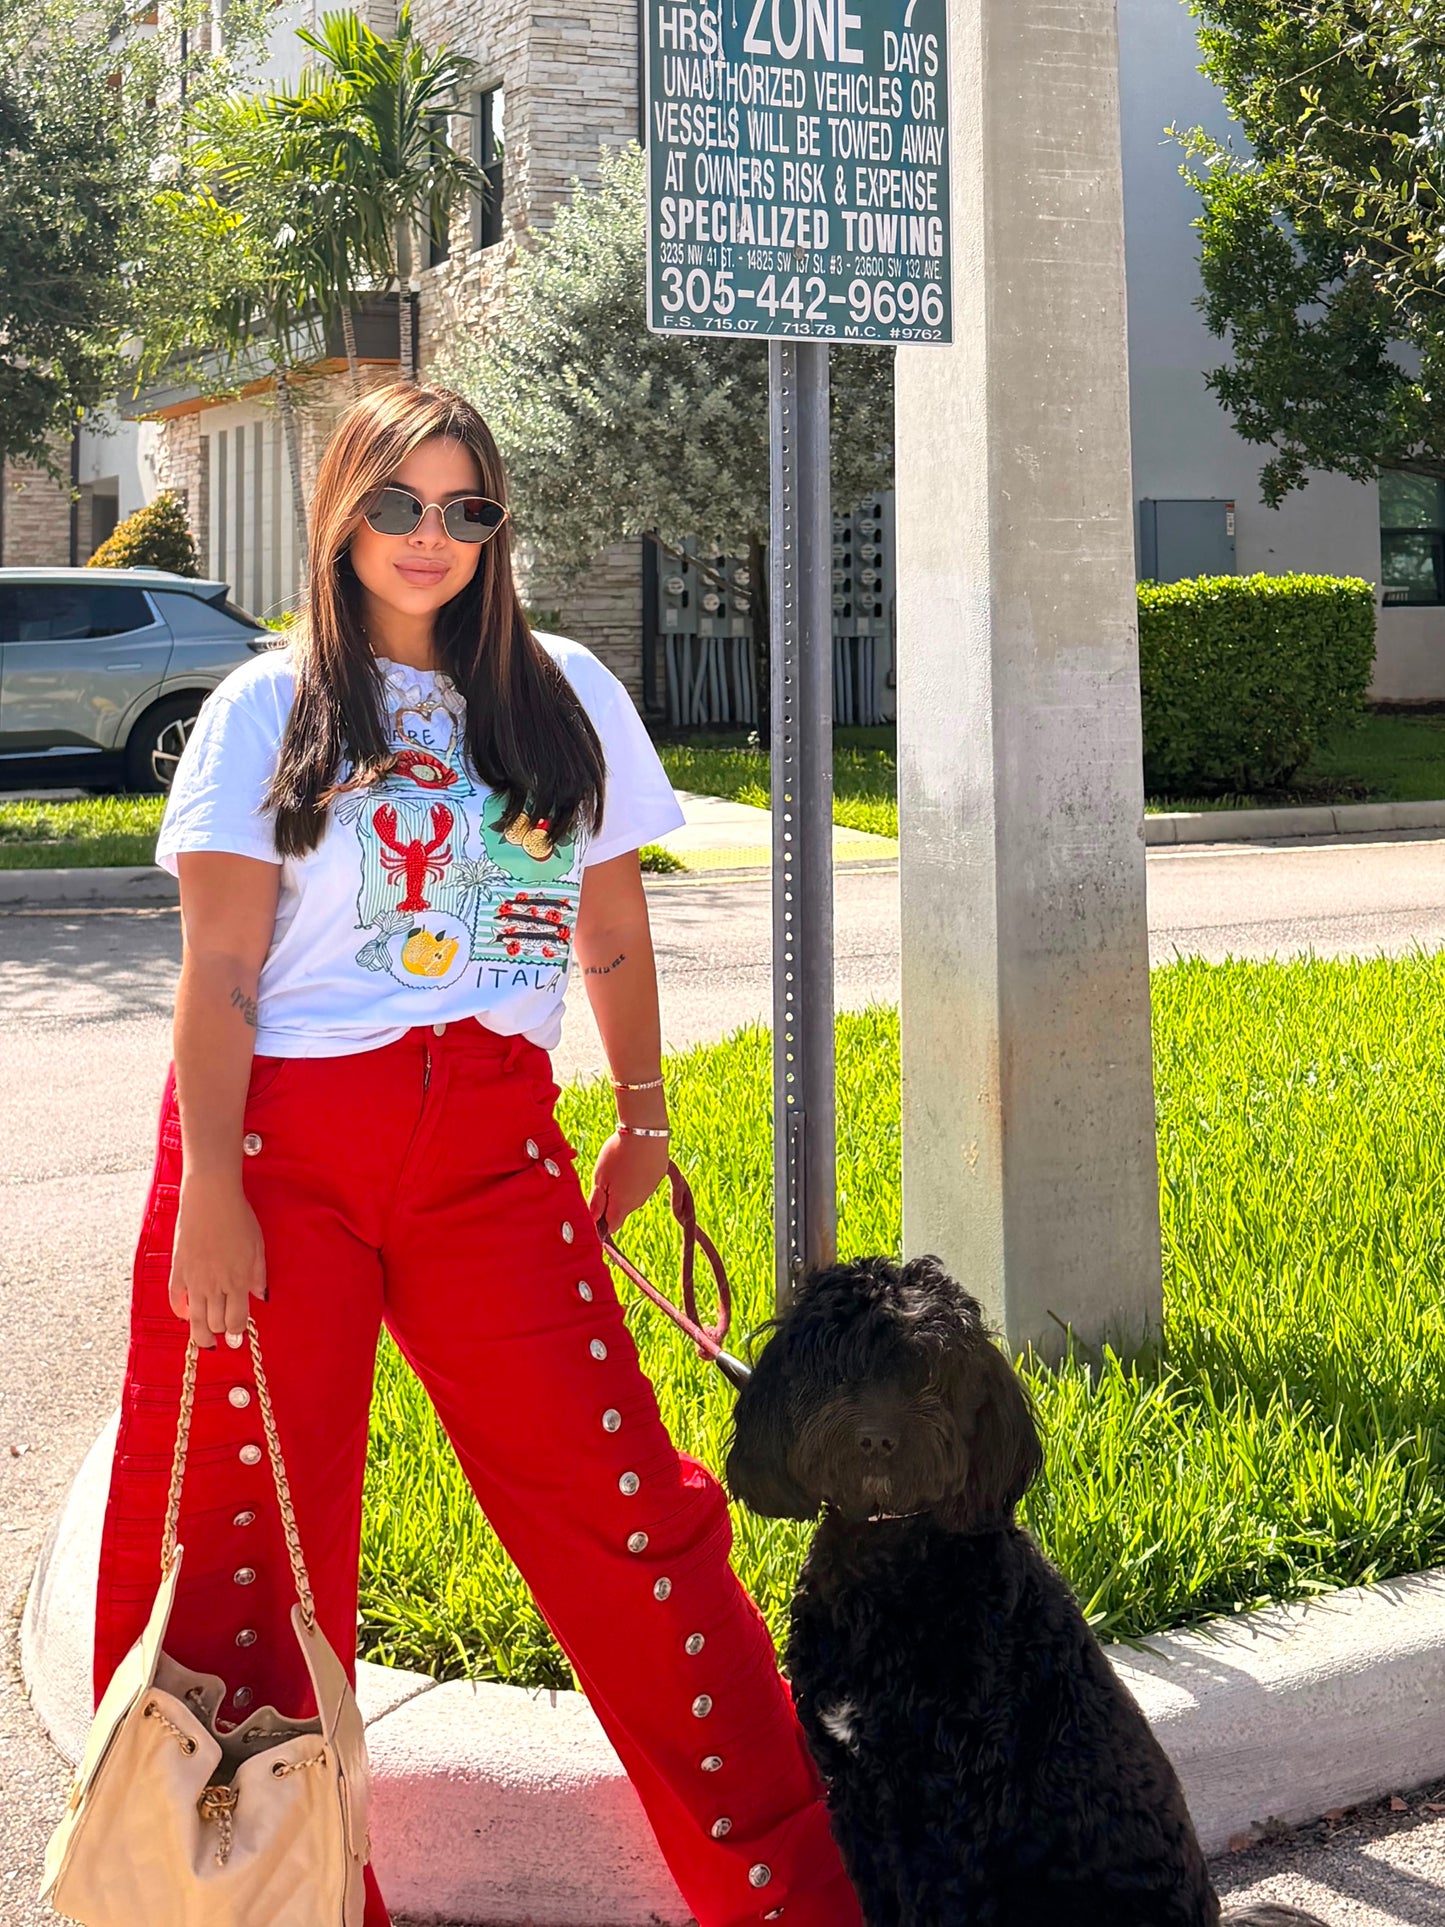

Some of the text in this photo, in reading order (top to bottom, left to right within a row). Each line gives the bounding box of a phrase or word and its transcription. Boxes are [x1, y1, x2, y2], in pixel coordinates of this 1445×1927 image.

[659, 6, 718, 53] HRS
[743, 0, 864, 65] ZONE
[883, 30, 939, 77] DAYS
[663, 55, 936, 121] UNAUTHORIZED VEHICLES OR
[654, 101, 945, 166] VESSELS WILL BE TOWED AWAY
[664, 150, 937, 211] AT OWNERS RISK & EXPENSE
[660, 196, 943, 257] SPECIALIZED TOWING
[660, 242, 684, 264] 3235
[687, 244, 703, 265] NW
[706, 246, 717, 266] 41
[747, 249, 774, 271] 14825
[777, 251, 791, 272] SW
[855, 256, 884, 277] 23600
[887, 257, 902, 278] SW
[906, 258, 920, 279] 132
[660, 266, 944, 327] 305-442-9696
[663, 315, 696, 328] F.S.
[703, 317, 758, 331] 715.07
[781, 322, 836, 336] 713.78
[844, 325, 881, 337] M.C.
[889, 327, 942, 341] #9762
